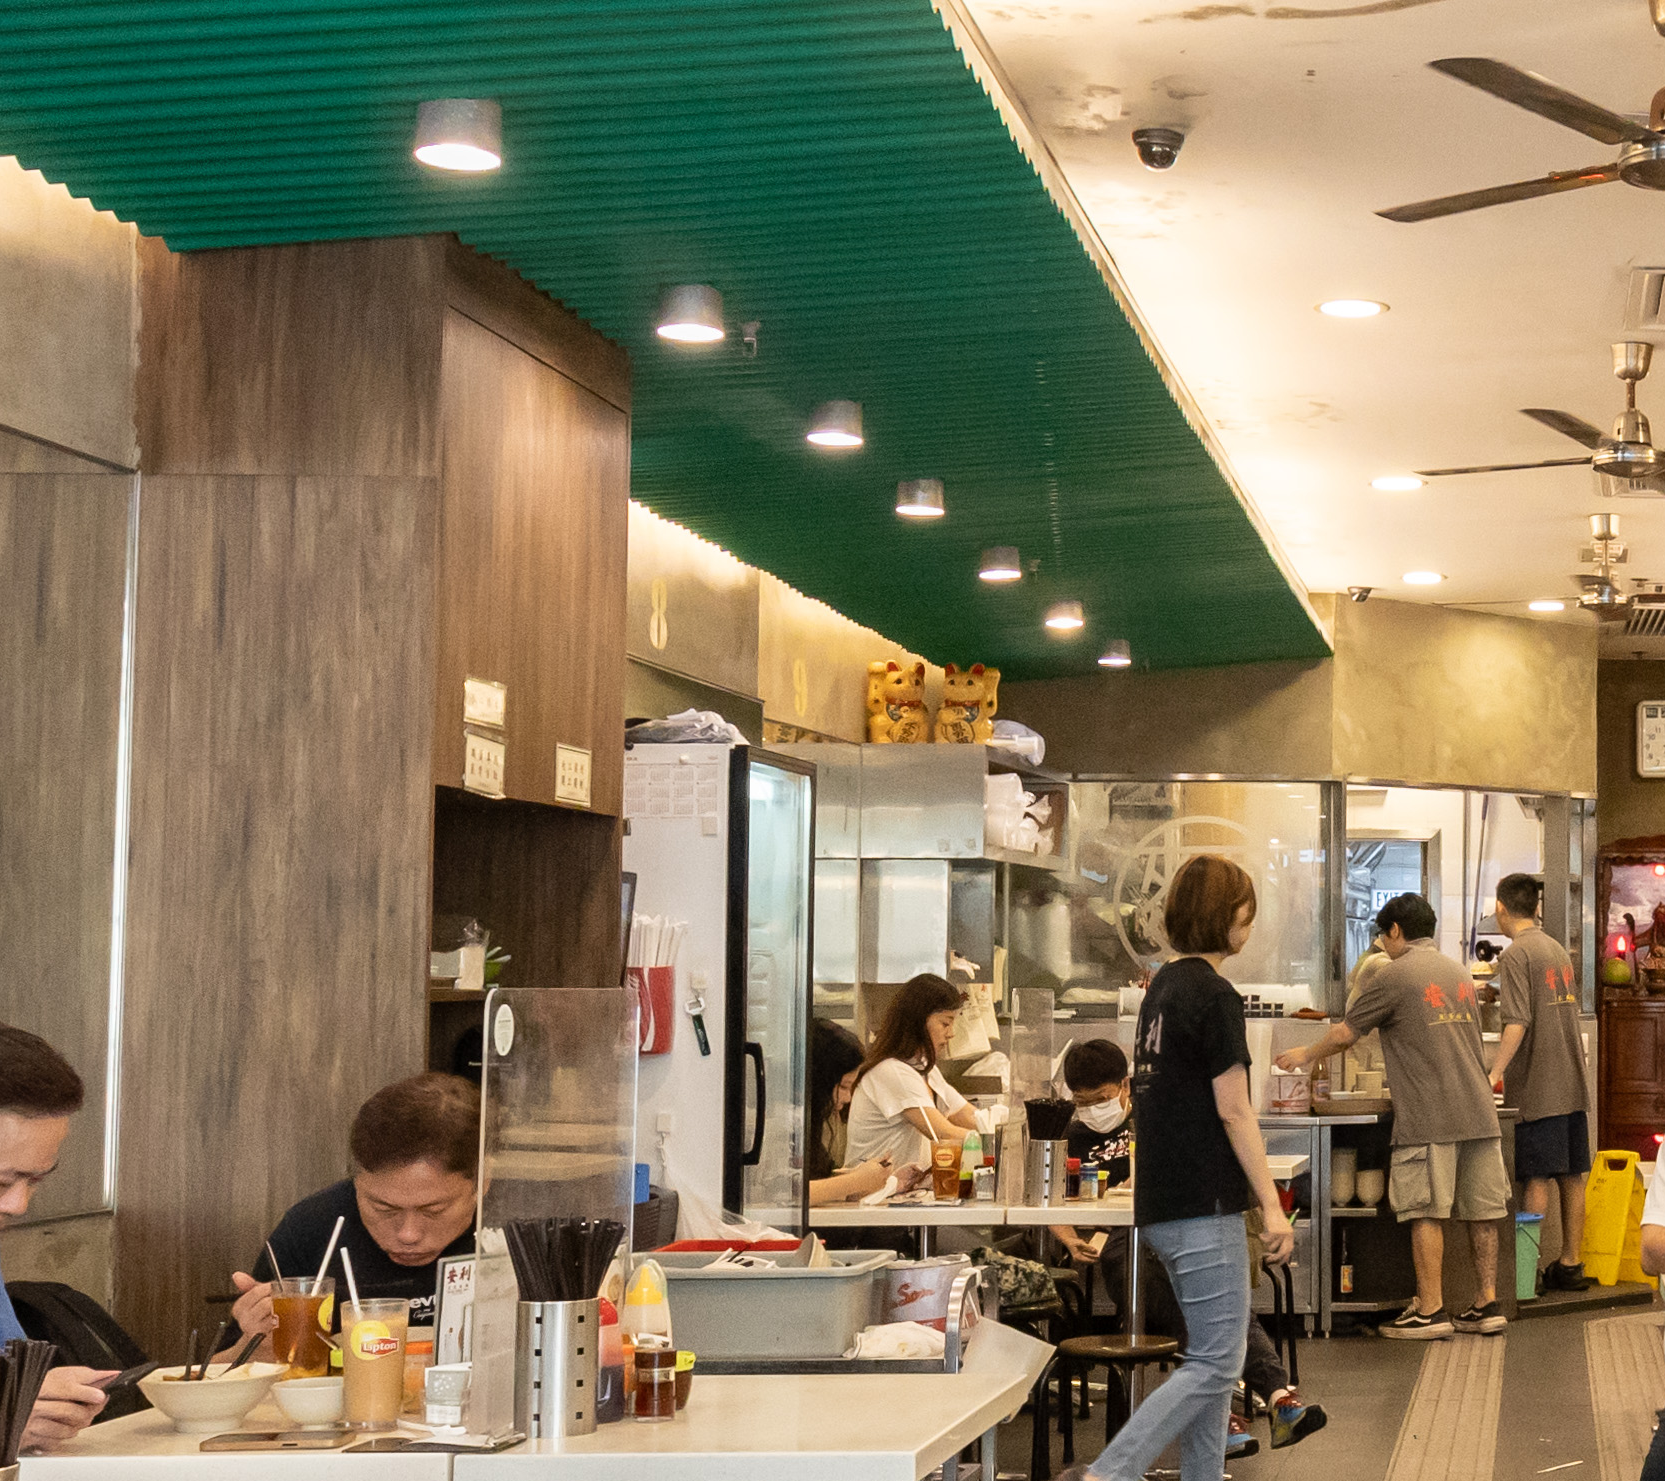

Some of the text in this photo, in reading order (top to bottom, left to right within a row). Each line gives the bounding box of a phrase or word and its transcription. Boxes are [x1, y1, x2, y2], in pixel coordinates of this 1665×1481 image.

[649, 577, 668, 650] 8
[1376, 892, 1400, 907] EX
[447, 1264, 472, 1284] 安利
[363, 1340, 398, 1355] Lipton
